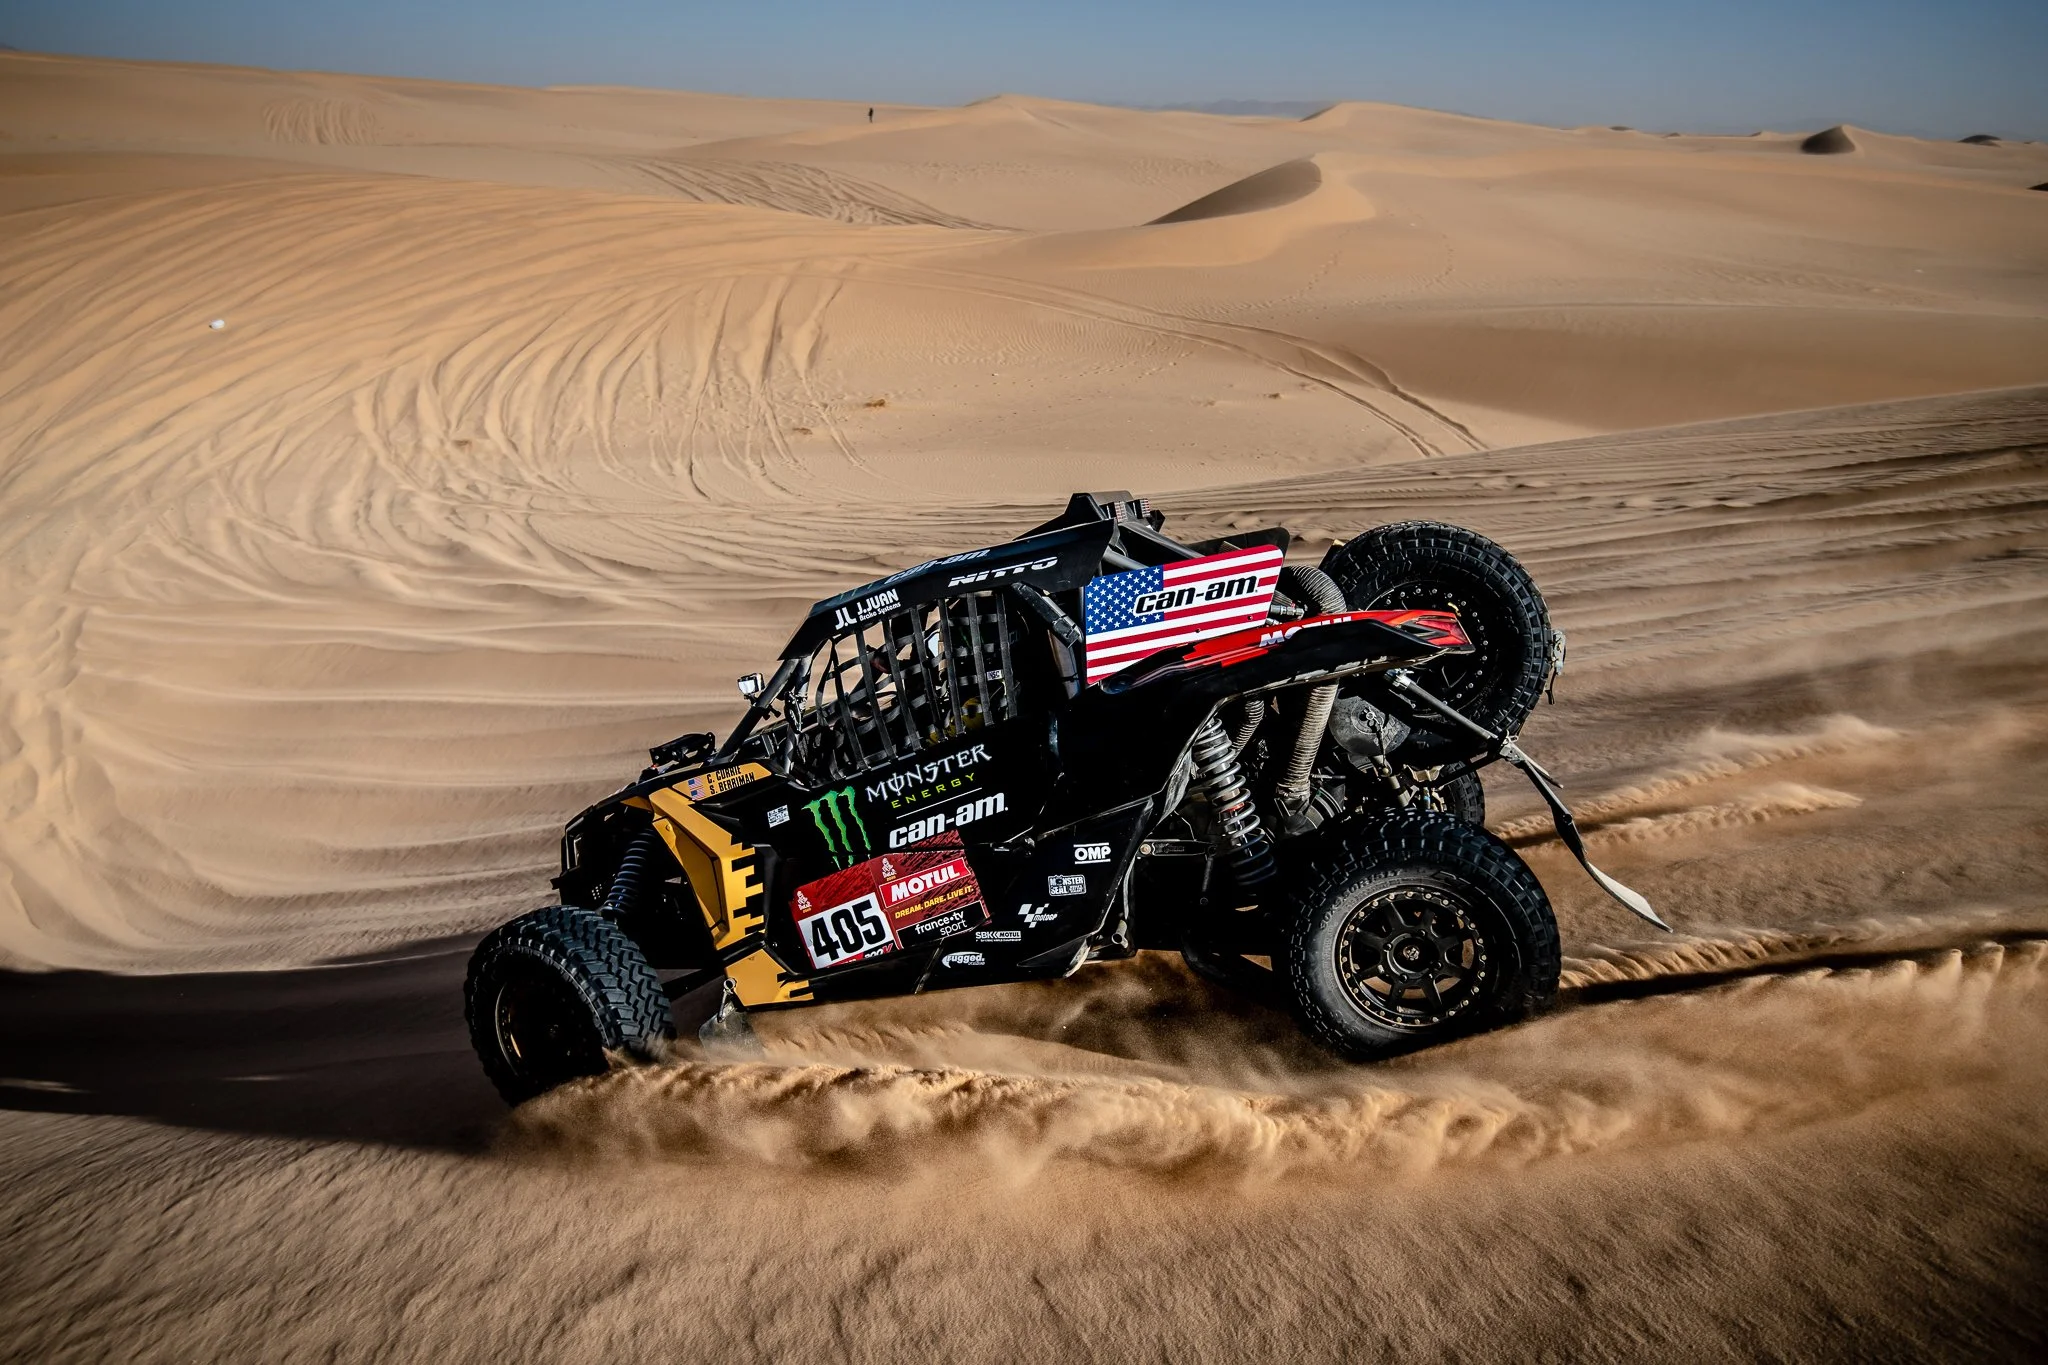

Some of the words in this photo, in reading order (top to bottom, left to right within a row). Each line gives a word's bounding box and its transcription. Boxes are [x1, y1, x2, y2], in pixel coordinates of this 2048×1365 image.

[948, 556, 1058, 587] NITTO
[859, 611, 877, 621] Brake
[877, 602, 901, 615] Systems
[709, 784, 718, 794] S.
[718, 771, 756, 791] BERRIMAN
[716, 765, 742, 781] CURRIE
[891, 772, 974, 809] ENERGY
[1074, 845, 1112, 861] OMP
[891, 865, 960, 902] MOTUL
[894, 903, 924, 919] DREAM.
[923, 895, 947, 909] DARE.
[946, 888, 964, 901] LIVE
[964, 884, 975, 894] IT.
[811, 898, 886, 961] 405
[939, 919, 968, 936] sport
[975, 931, 994, 939] SBK
